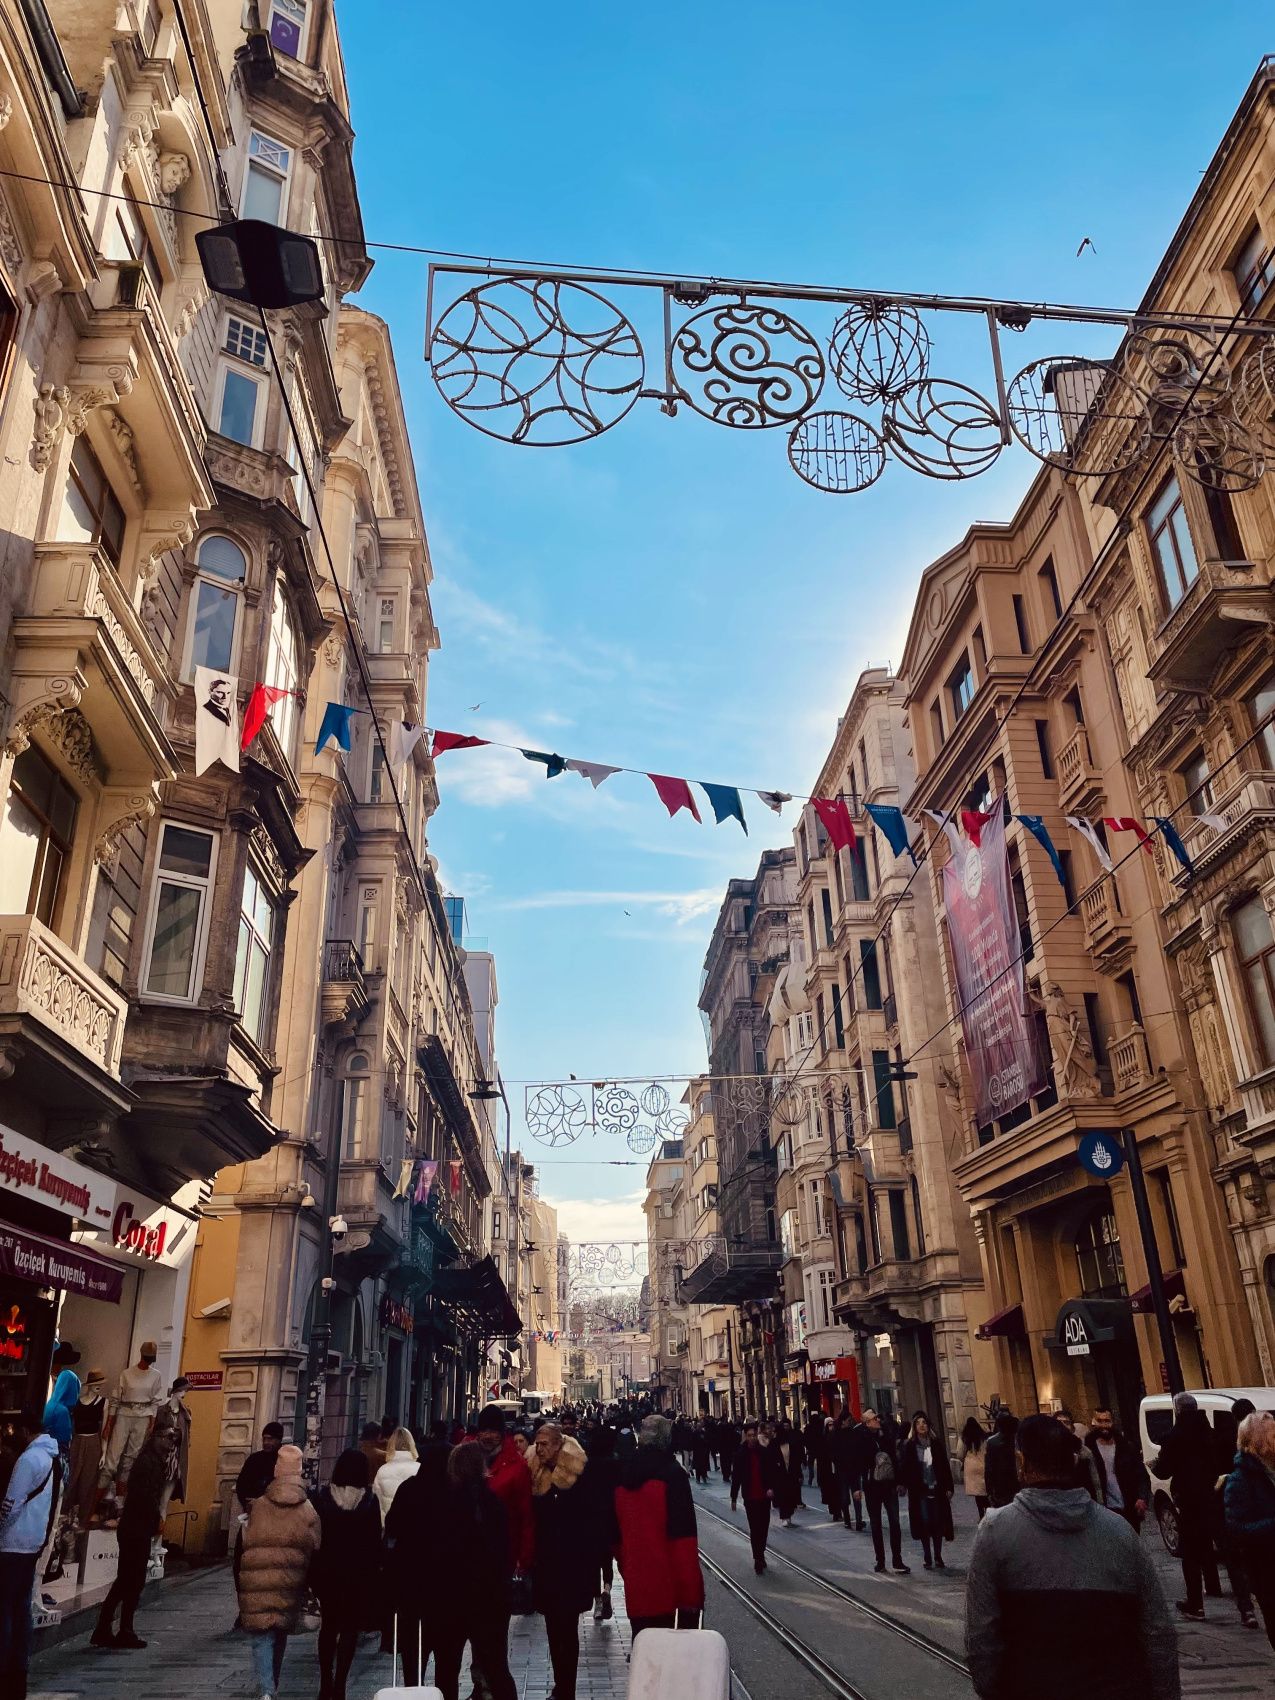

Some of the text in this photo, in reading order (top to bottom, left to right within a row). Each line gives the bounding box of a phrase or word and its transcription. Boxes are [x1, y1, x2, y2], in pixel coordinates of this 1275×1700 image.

[112, 1202, 167, 1260] Coral
[14, 1240, 46, 1276] Özçiçek
[48, 1256, 86, 1290] Kuruyemiş
[1065, 1316, 1088, 1344] ADA
